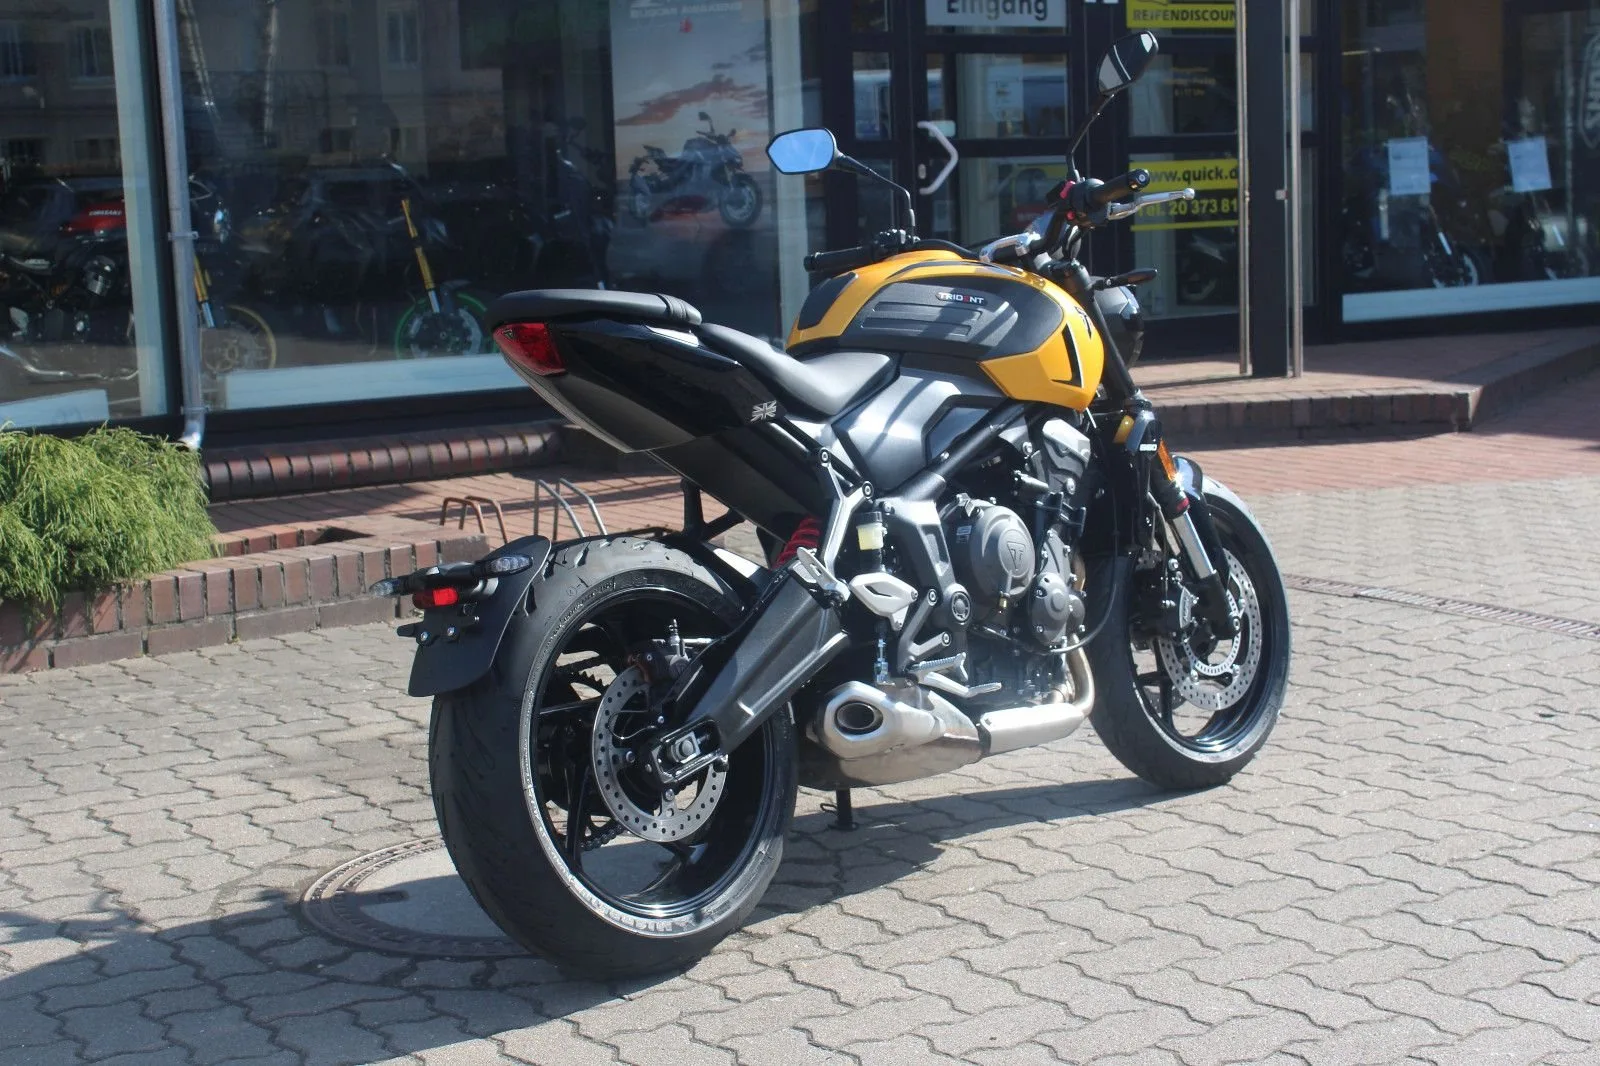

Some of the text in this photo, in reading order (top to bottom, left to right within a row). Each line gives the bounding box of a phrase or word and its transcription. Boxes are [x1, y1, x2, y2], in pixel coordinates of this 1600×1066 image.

[947, 0, 1048, 21] Eingang
[1133, 9, 1237, 21] REIFENDISCOUN
[1169, 200, 1188, 215] 20
[1191, 199, 1218, 214] 373
[938, 292, 984, 304] TRIDENT
